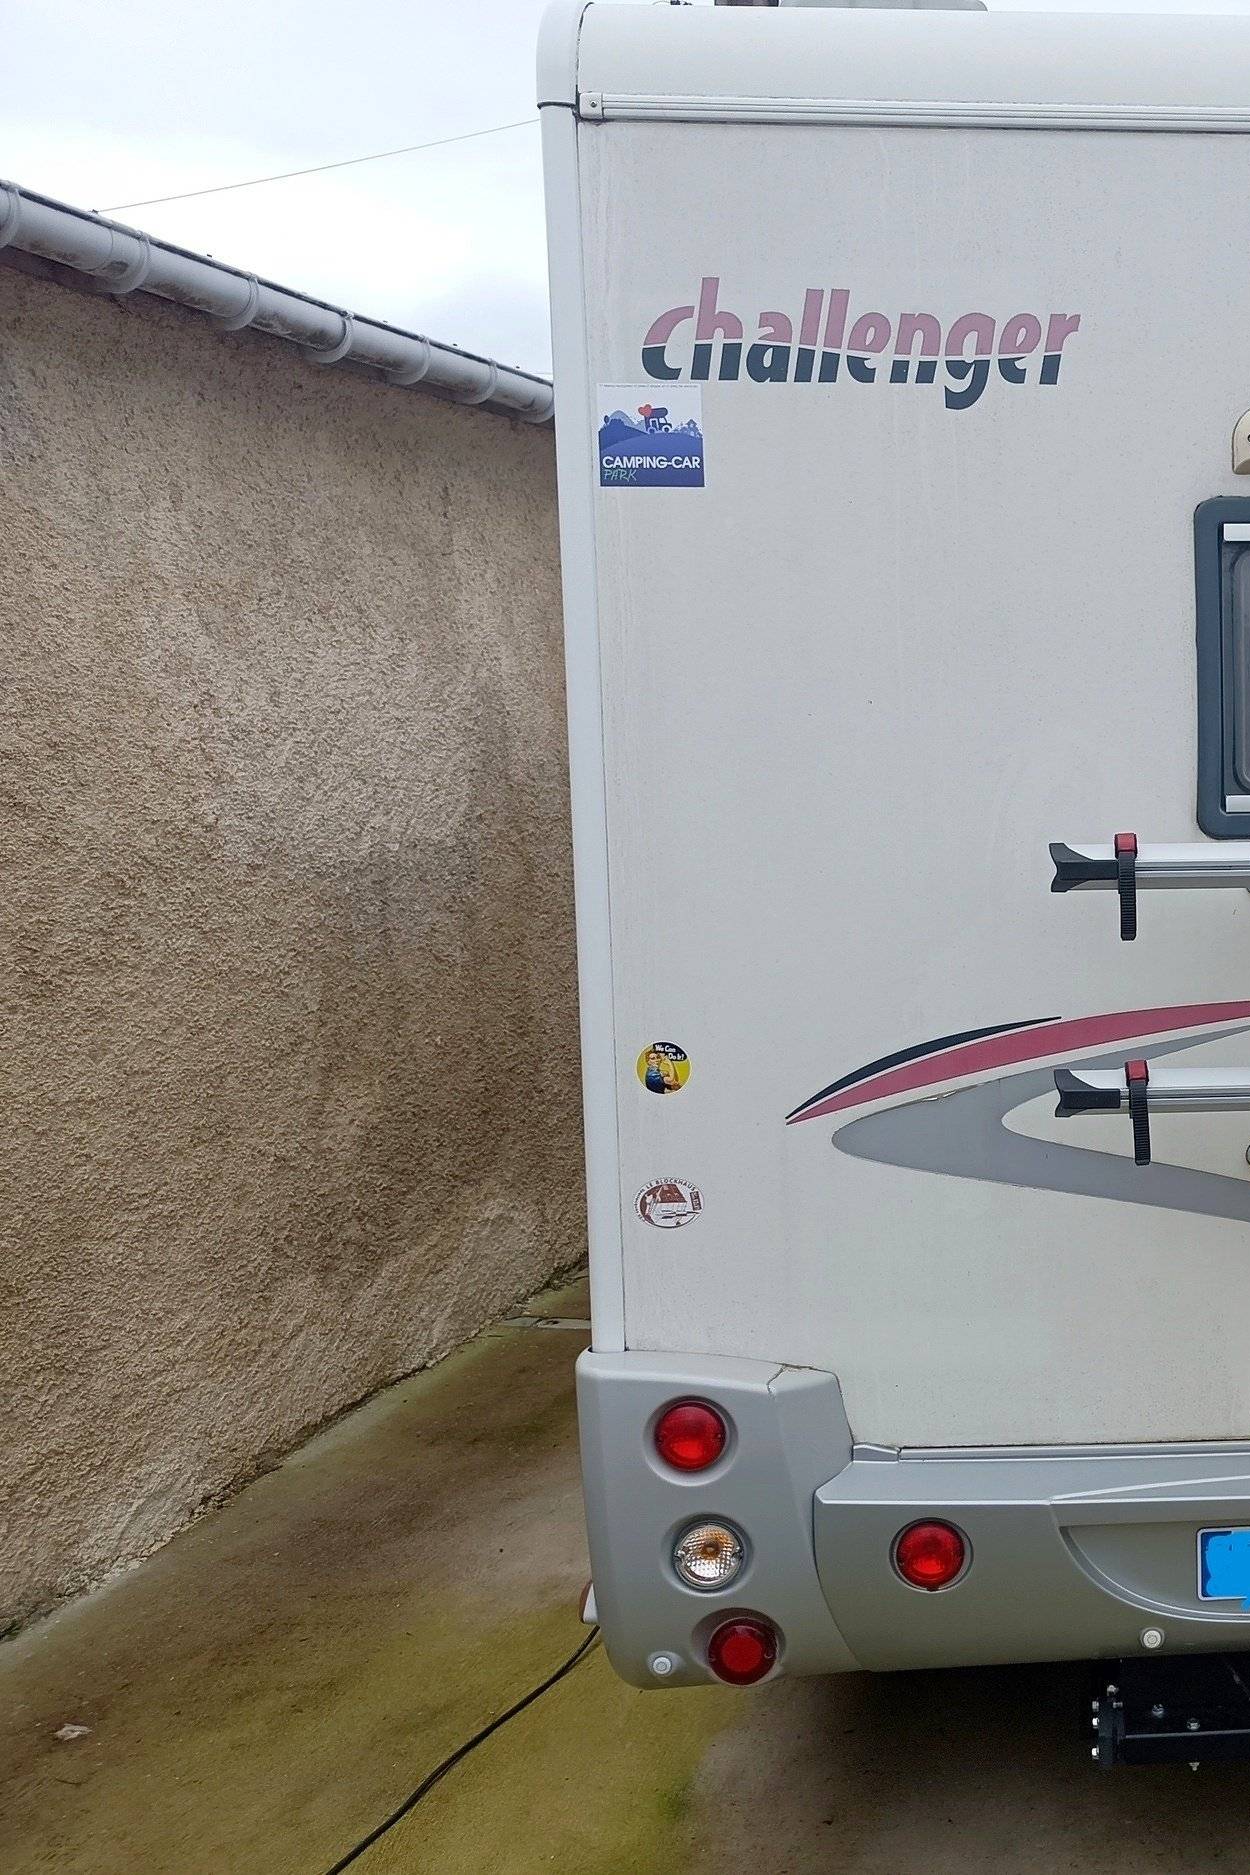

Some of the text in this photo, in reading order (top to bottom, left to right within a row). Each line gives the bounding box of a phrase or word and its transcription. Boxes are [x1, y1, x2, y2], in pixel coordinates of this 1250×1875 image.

[641, 276, 1081, 410] challenger
[602, 456, 701, 469] CAMPING-CAR
[603, 469, 637, 482] PARK
[655, 1178, 696, 1191] BLOCKHAUS
